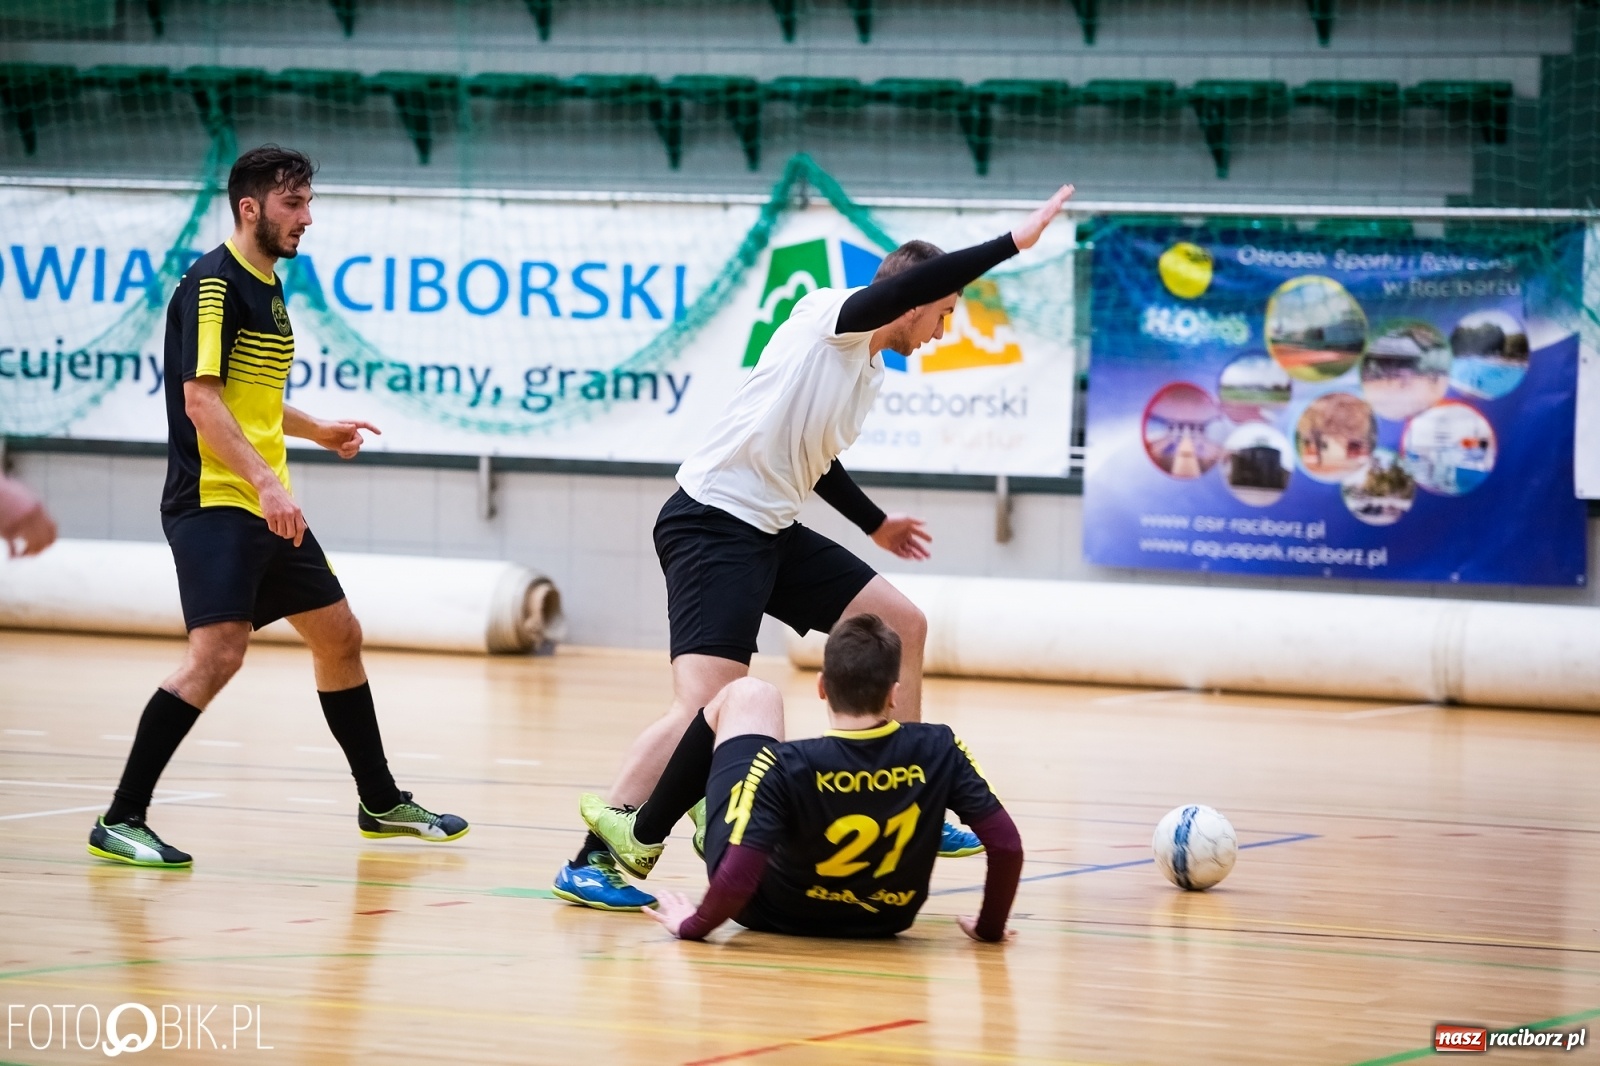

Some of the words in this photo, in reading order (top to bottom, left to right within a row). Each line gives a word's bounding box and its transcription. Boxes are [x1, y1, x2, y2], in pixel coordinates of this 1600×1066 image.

[284, 253, 687, 320] ACIBORSKI
[286, 345, 504, 408] pieramy,
[521, 364, 690, 414] gramy
[816, 765, 927, 794] KONOPA
[815, 802, 922, 879] 21
